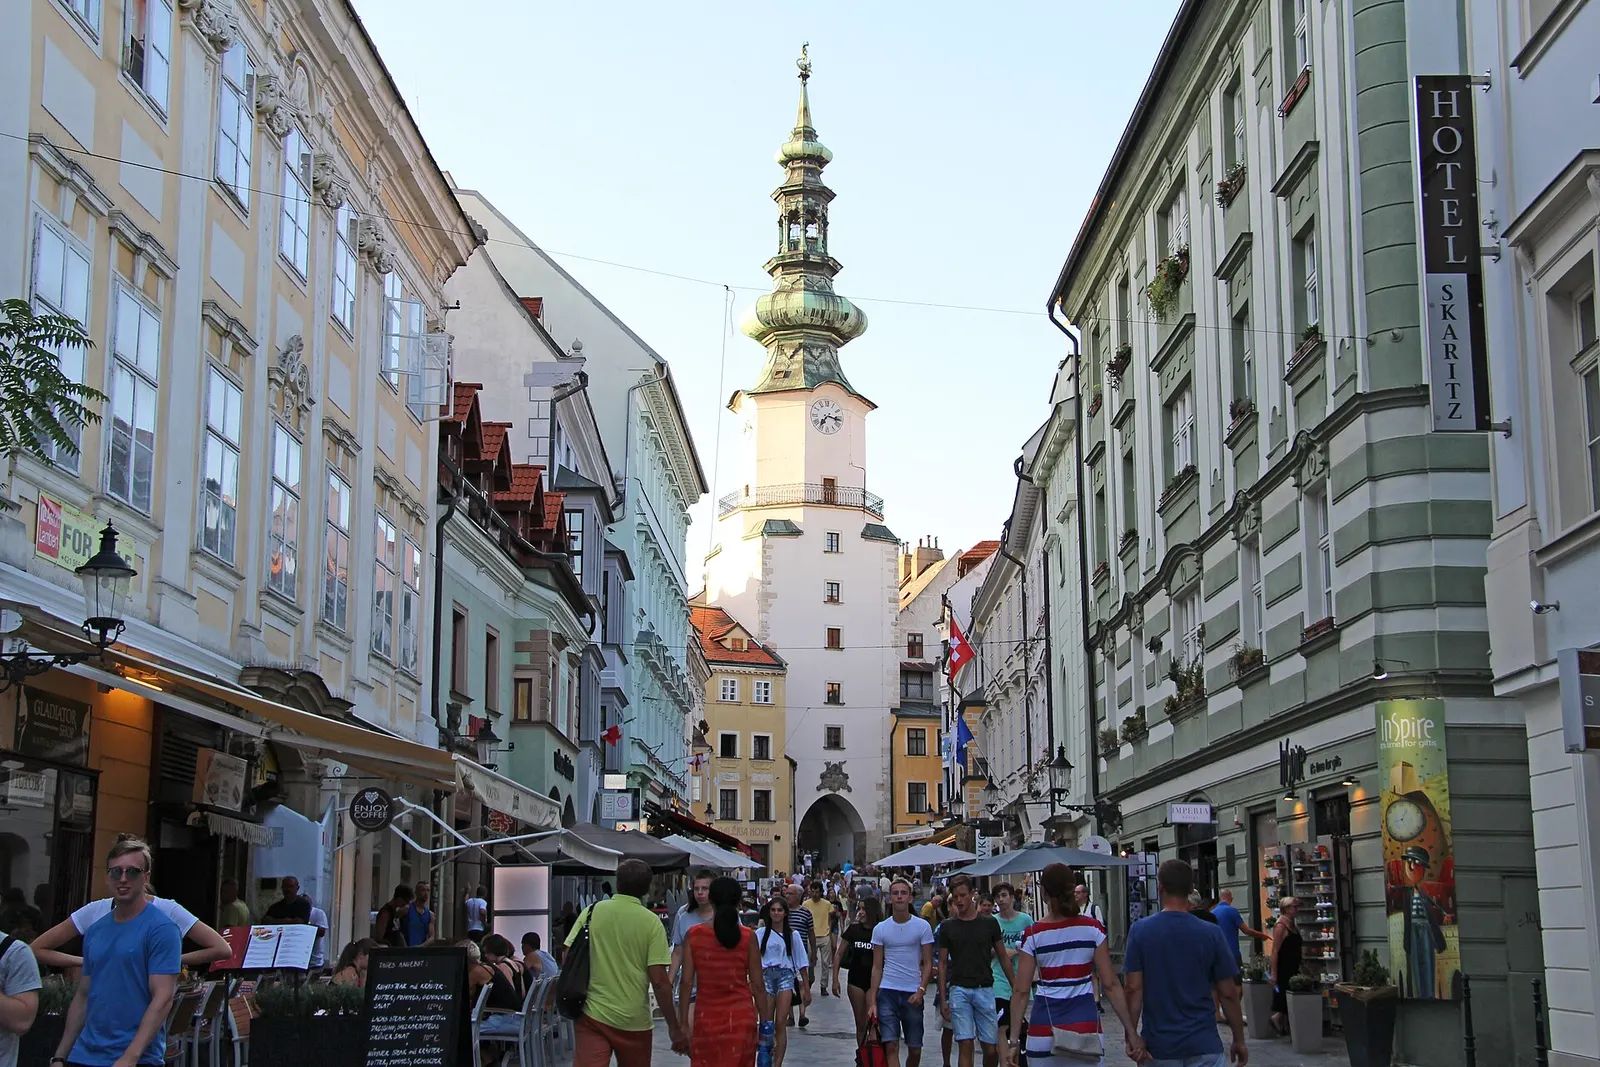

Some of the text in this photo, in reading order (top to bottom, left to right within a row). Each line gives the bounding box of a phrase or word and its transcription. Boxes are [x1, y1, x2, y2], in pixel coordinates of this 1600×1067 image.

[1429, 90, 1467, 264] HOTEL
[1441, 284, 1463, 420] SKARITZ
[62, 522, 93, 560] FOR
[33, 699, 78, 731] GLADIATOR
[58, 724, 76, 739] SHOP
[1380, 712, 1434, 748] InSpire
[353, 811, 388, 819] COFFEE
[354, 804, 389, 812] ENJOY
